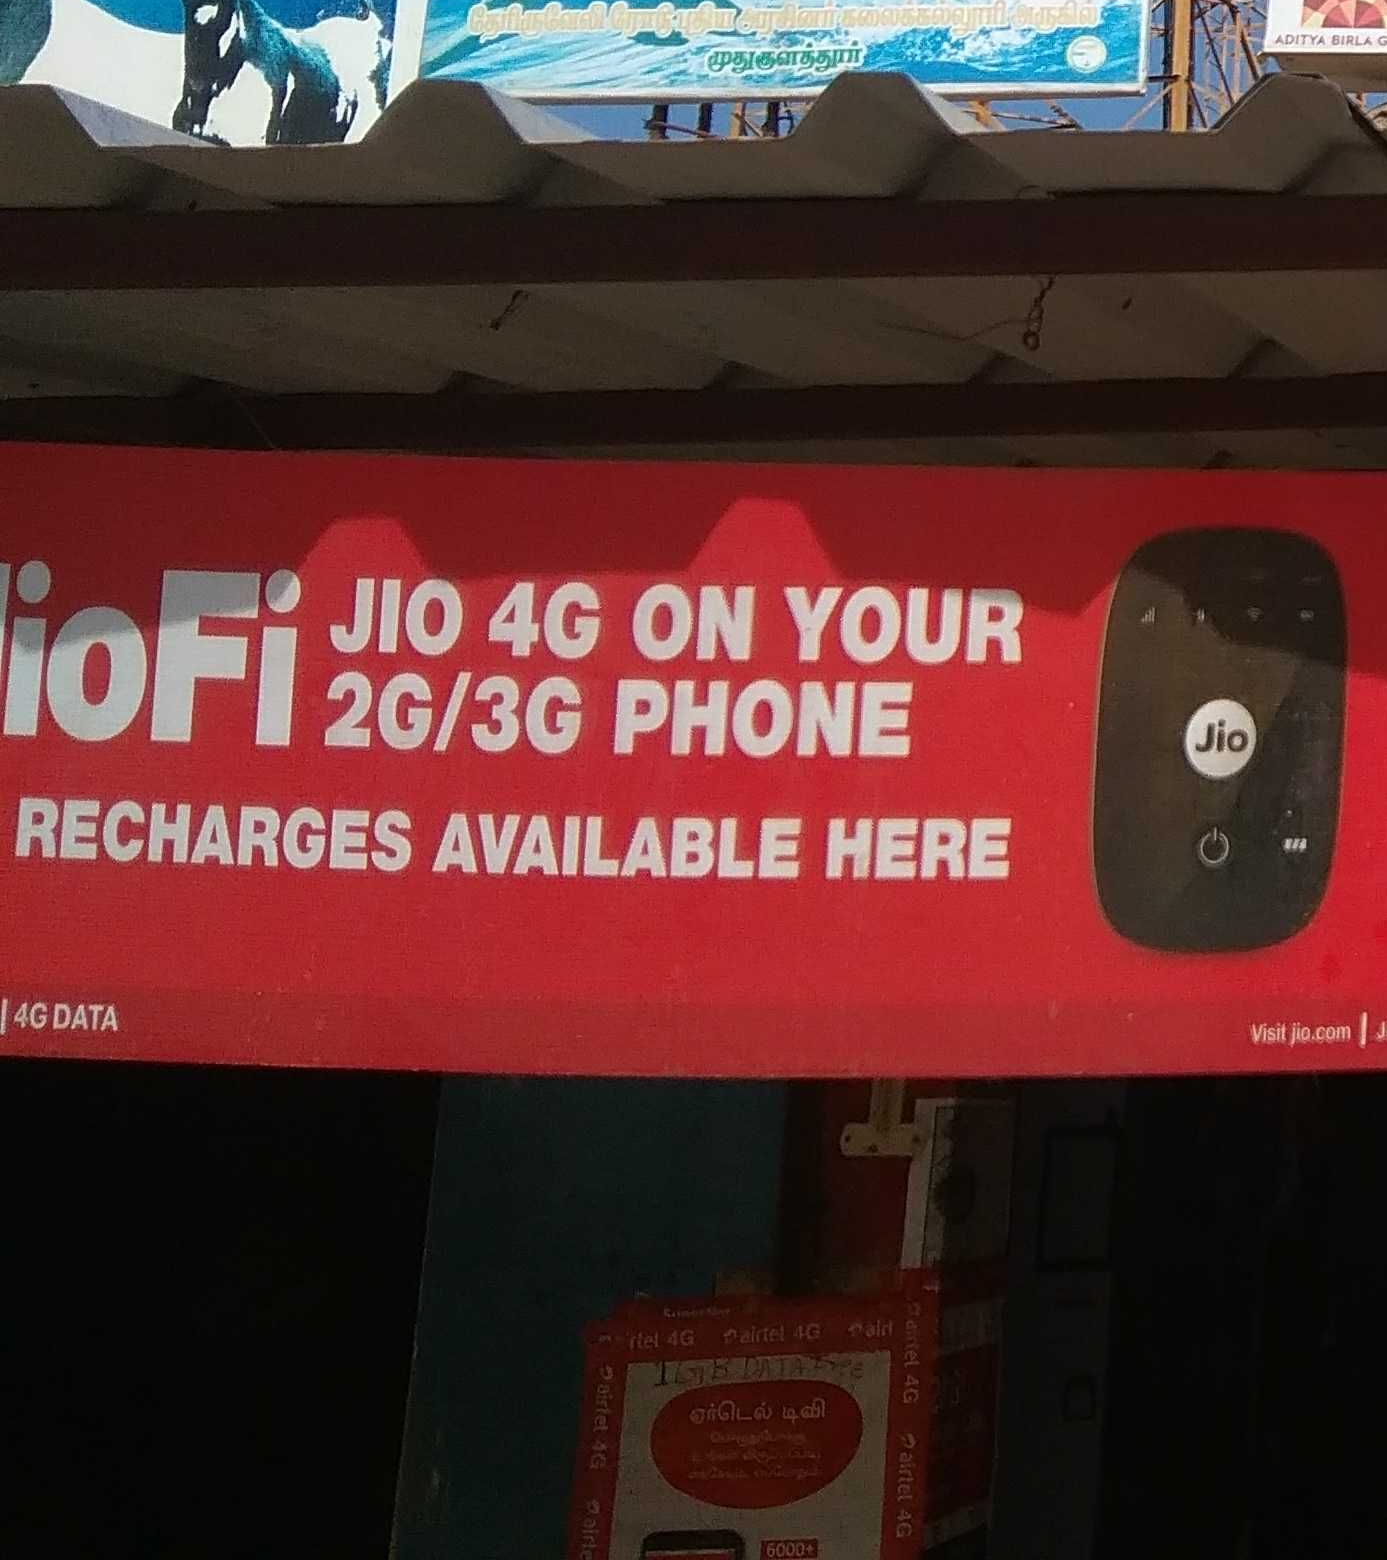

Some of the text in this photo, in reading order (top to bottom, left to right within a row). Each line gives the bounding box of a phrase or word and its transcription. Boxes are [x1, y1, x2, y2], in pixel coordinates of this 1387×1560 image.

[1275, 33, 1327, 46] ADITYA
[1331, 34, 1374, 47] BIRLA
[329, 577, 1025, 664] JIO 4G ON YOUR
[324, 670, 915, 758] 2G/3G PHONE
[1193, 720, 1249, 755] Jio
[14, 796, 1013, 881] RECHARGES AVAILABLE HERE
[13, 1002, 121, 1034] 4G DATA
[1250, 1022, 1352, 1048] Visit jio.com
